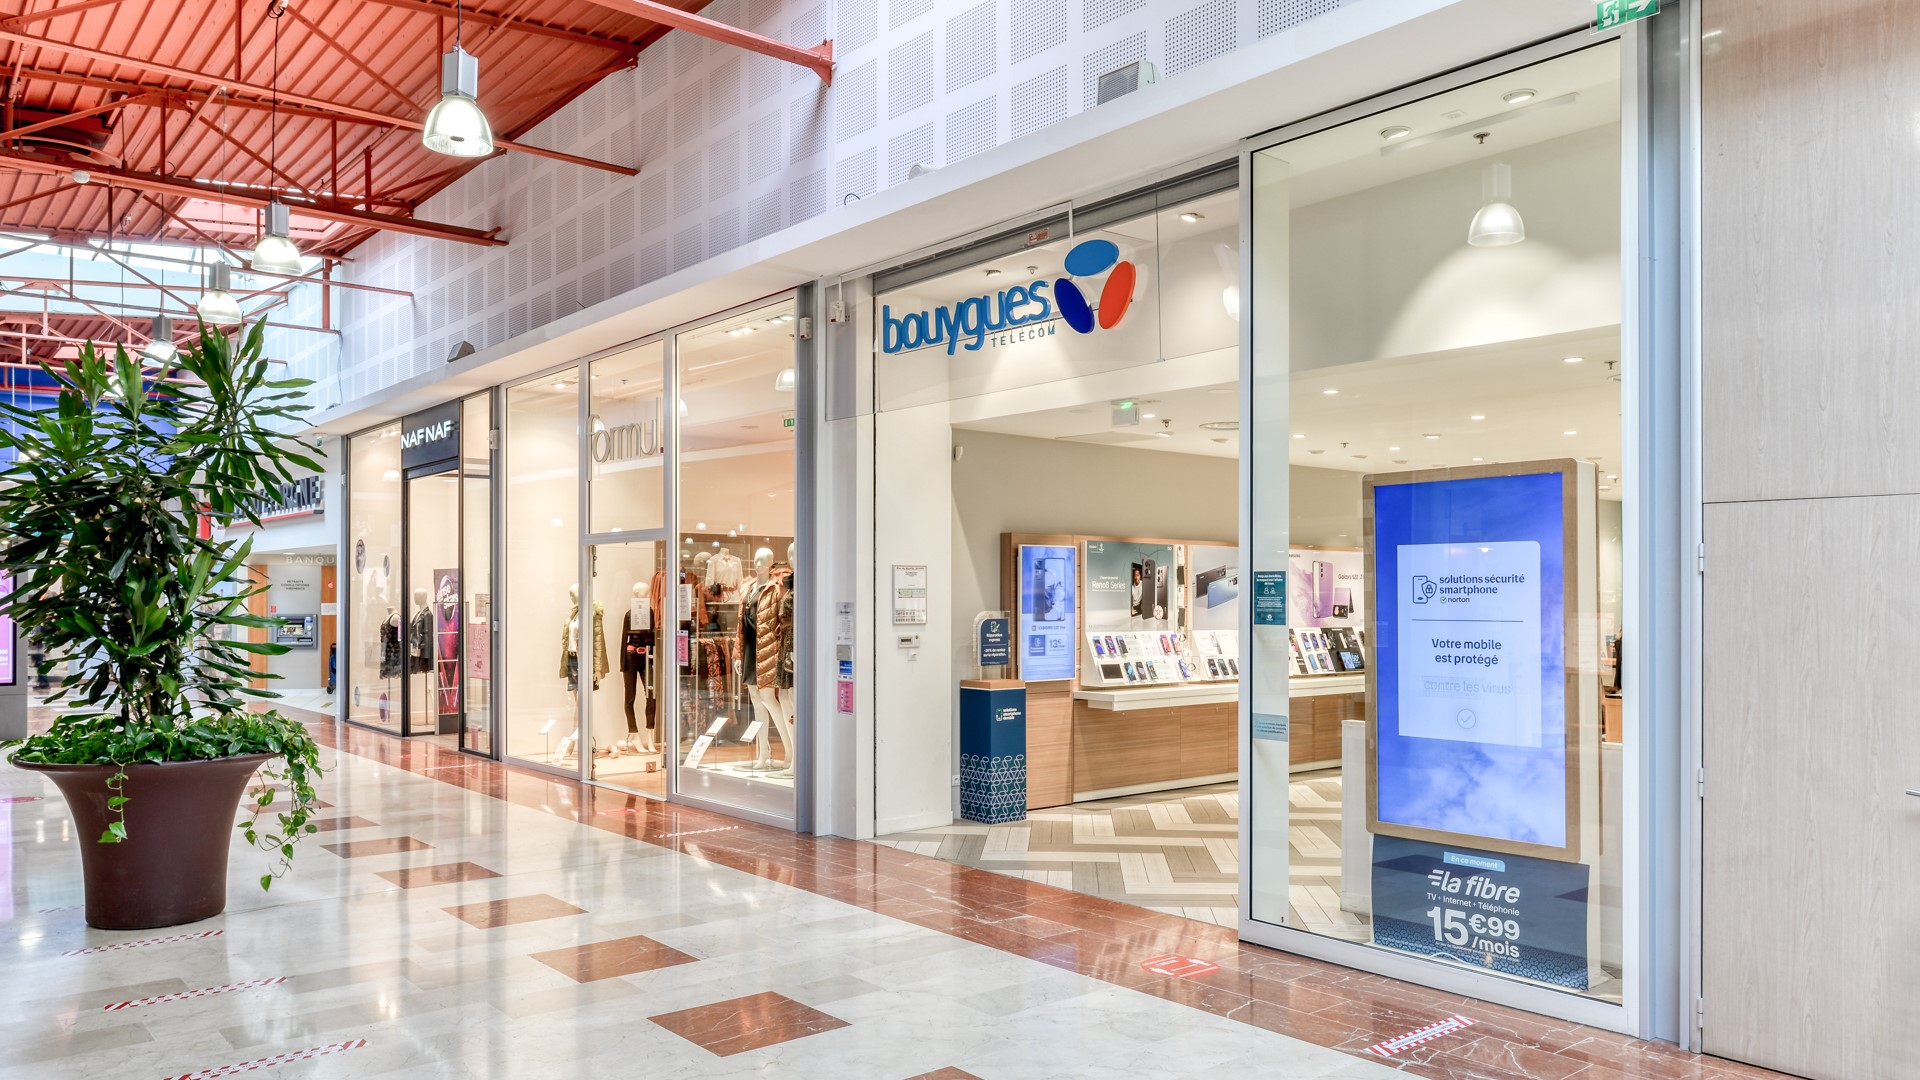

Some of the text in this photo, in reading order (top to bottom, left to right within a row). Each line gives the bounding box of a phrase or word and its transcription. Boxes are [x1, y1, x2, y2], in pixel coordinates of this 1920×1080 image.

[882, 280, 1051, 356] bouygues
[400, 420, 451, 450] NAF NAF
[1092, 581, 1125, 589] Reno8 Series
[1440, 574, 1525, 583] solutions sécurité
[1440, 584, 1498, 595] smartphone
[1432, 638, 1502, 650] Votre mobile
[1435, 654, 1499, 667] est protégé
[1424, 680, 1461, 692] contre
[1463, 681, 1480, 693] les
[1469, 859, 1498, 869] moment
[1440, 872, 1520, 903] la fibre
[1427, 893, 1437, 901] TV
[1443, 895, 1471, 908] Internet
[1478, 902, 1520, 916] Téléphonie
[1427, 906, 1520, 946] 15€99
[1472, 936, 1520, 958] /mois
